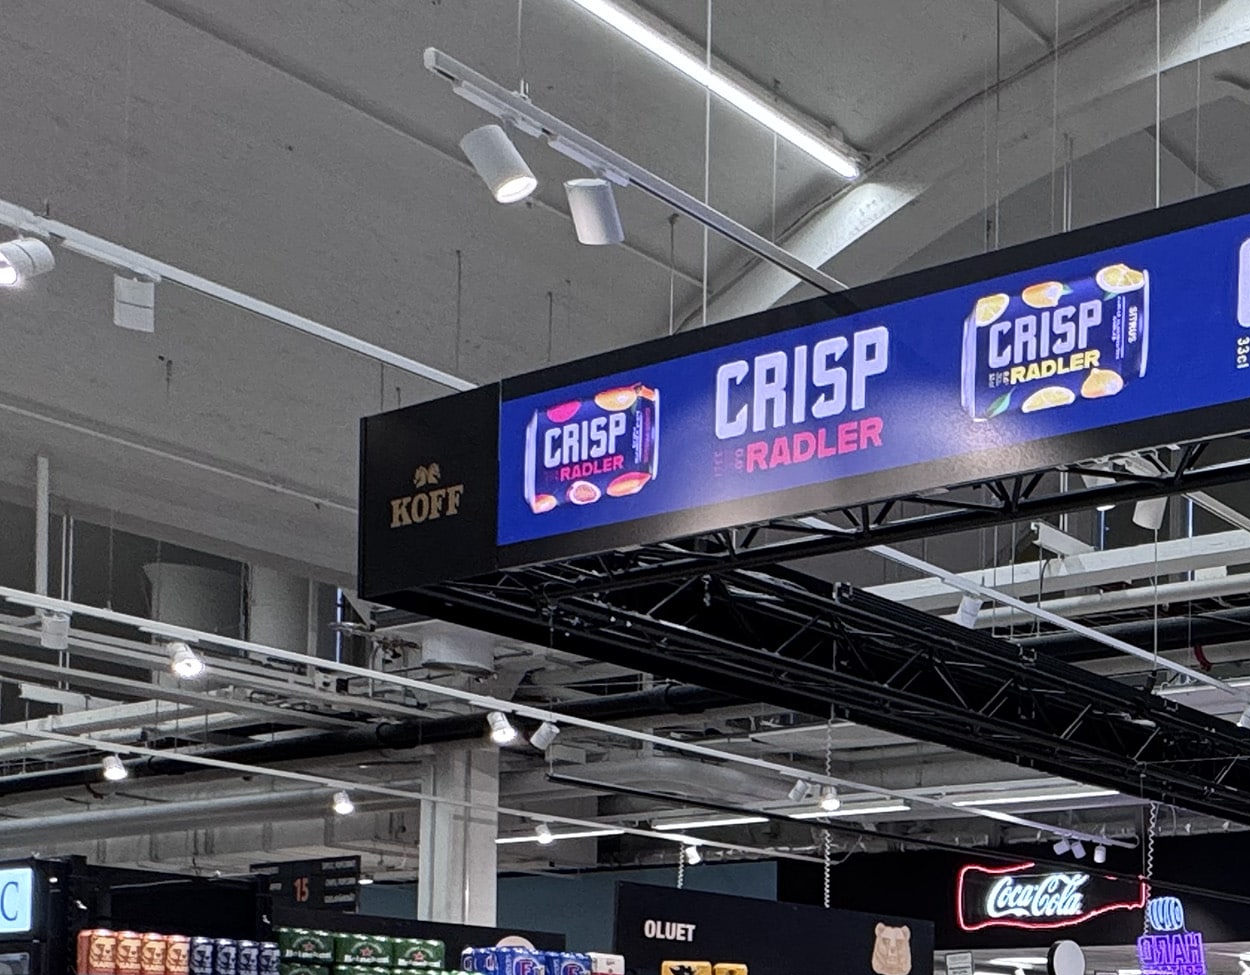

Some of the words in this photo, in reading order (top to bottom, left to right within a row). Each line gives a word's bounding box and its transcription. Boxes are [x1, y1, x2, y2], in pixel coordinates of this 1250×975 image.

[988, 299, 1102, 369] CRISP
[715, 326, 889, 439] CRISP
[1010, 349, 1101, 385] RADLER
[543, 412, 626, 468] CRISP
[746, 416, 884, 473] RADLER
[560, 455, 624, 481] RADLER
[390, 484, 464, 529] KOFF
[294, 877, 309, 902] 15
[644, 920, 696, 942] OLUET
